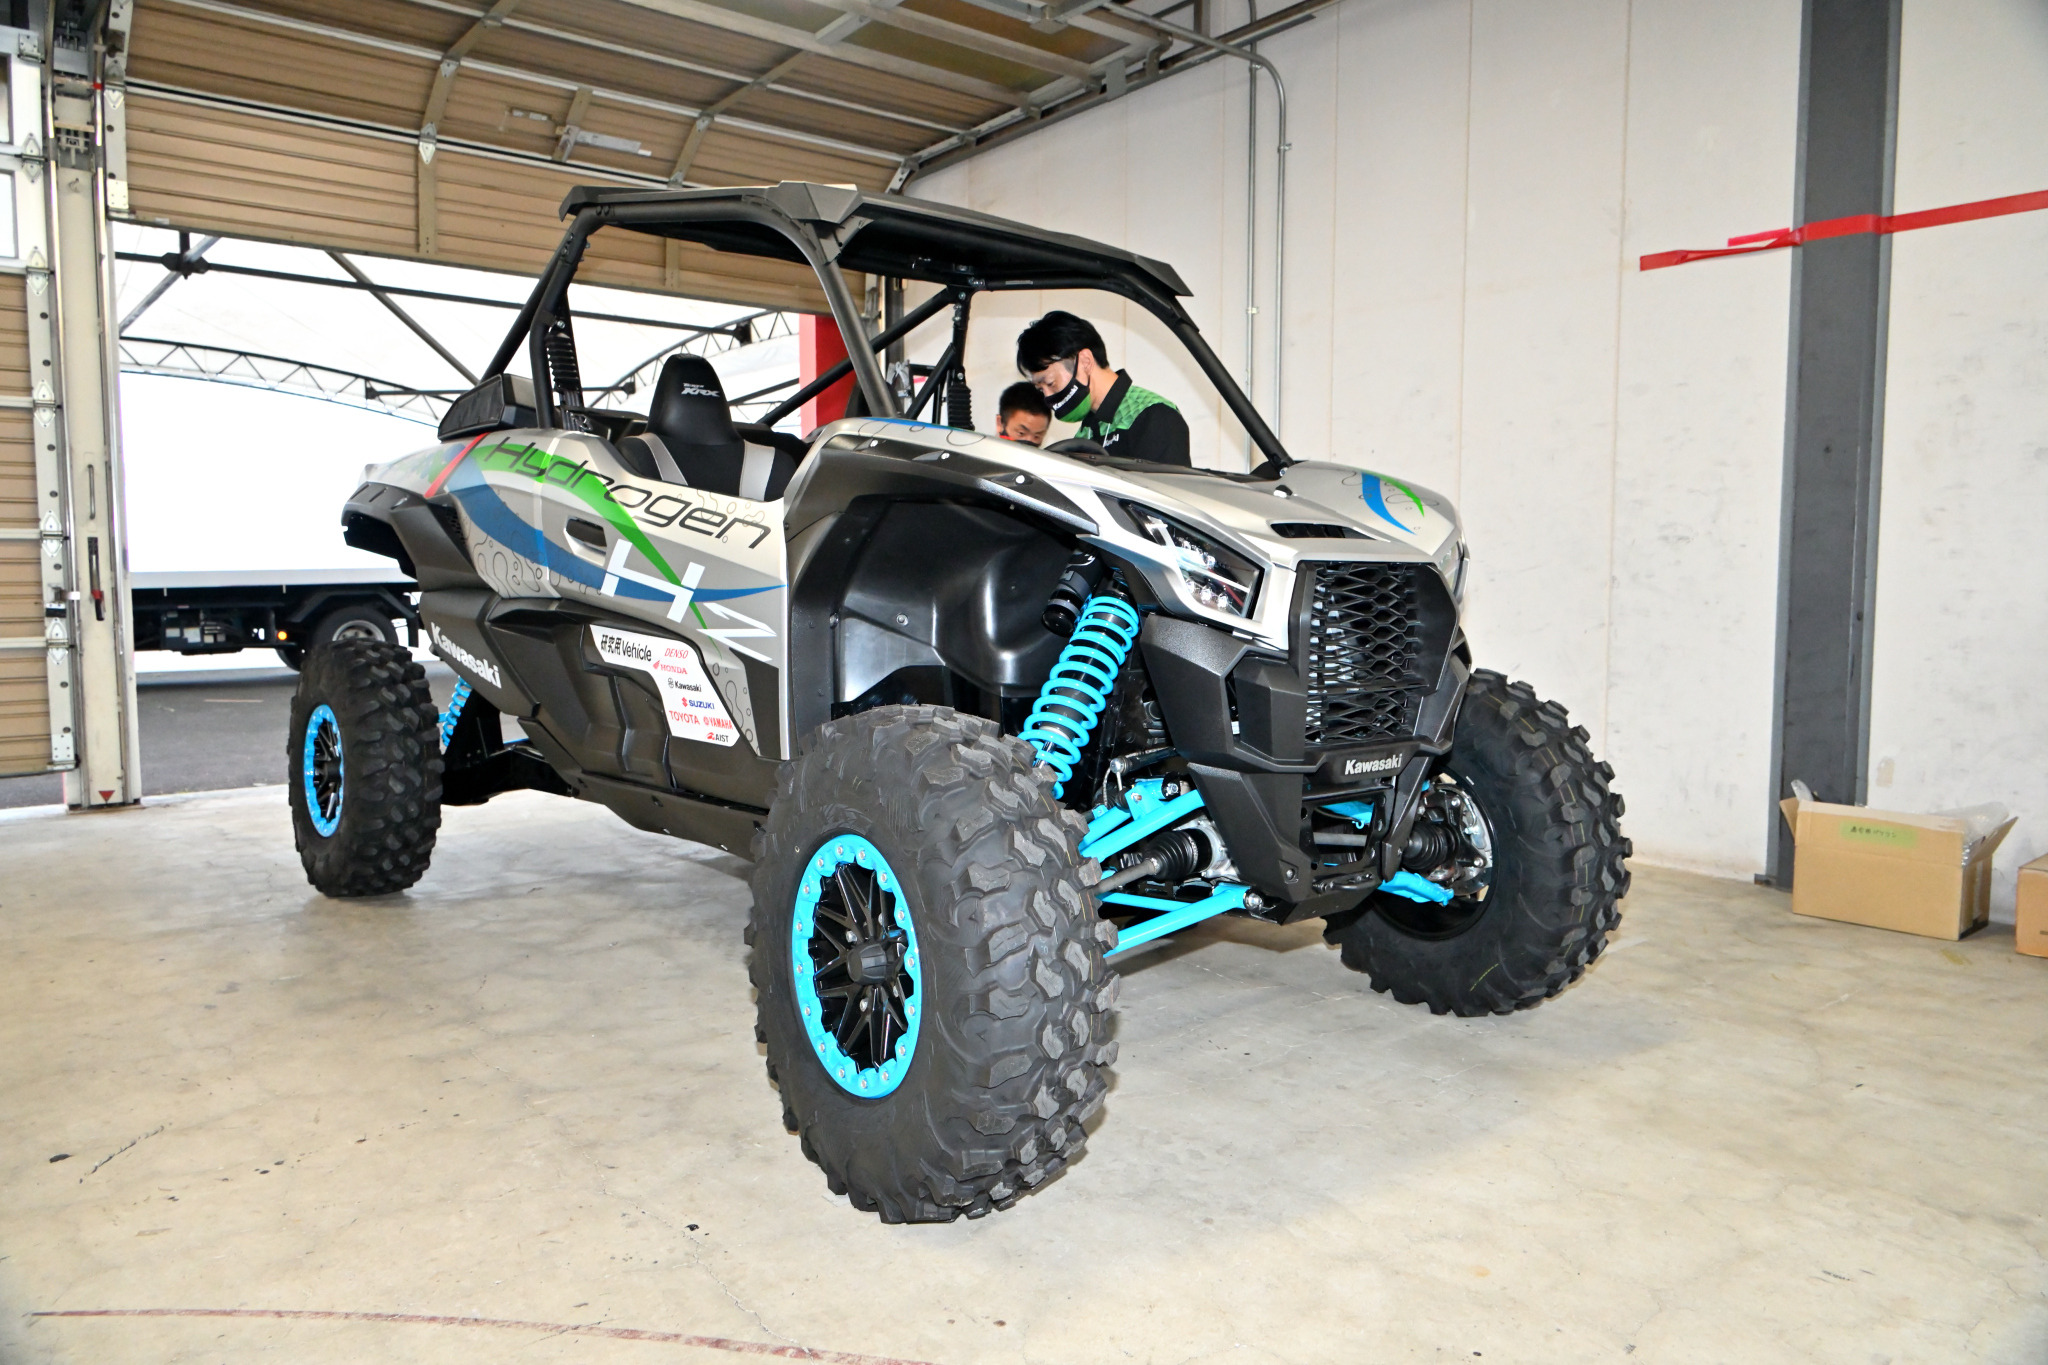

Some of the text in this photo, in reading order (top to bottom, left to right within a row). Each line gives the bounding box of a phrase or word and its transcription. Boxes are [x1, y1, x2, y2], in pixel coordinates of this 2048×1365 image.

[484, 436, 772, 549] Hydrogen
[431, 621, 502, 689] Kawasaki
[664, 647, 689, 659] DENSO
[660, 663, 688, 675] HONDA
[674, 680, 702, 692] Kawasaki
[688, 699, 715, 710] SUZUKI
[669, 710, 701, 726] TOYOTA
[709, 717, 733, 730] YAMAHA
[715, 733, 729, 743] AIST
[1344, 753, 1403, 775] Kawasaki
